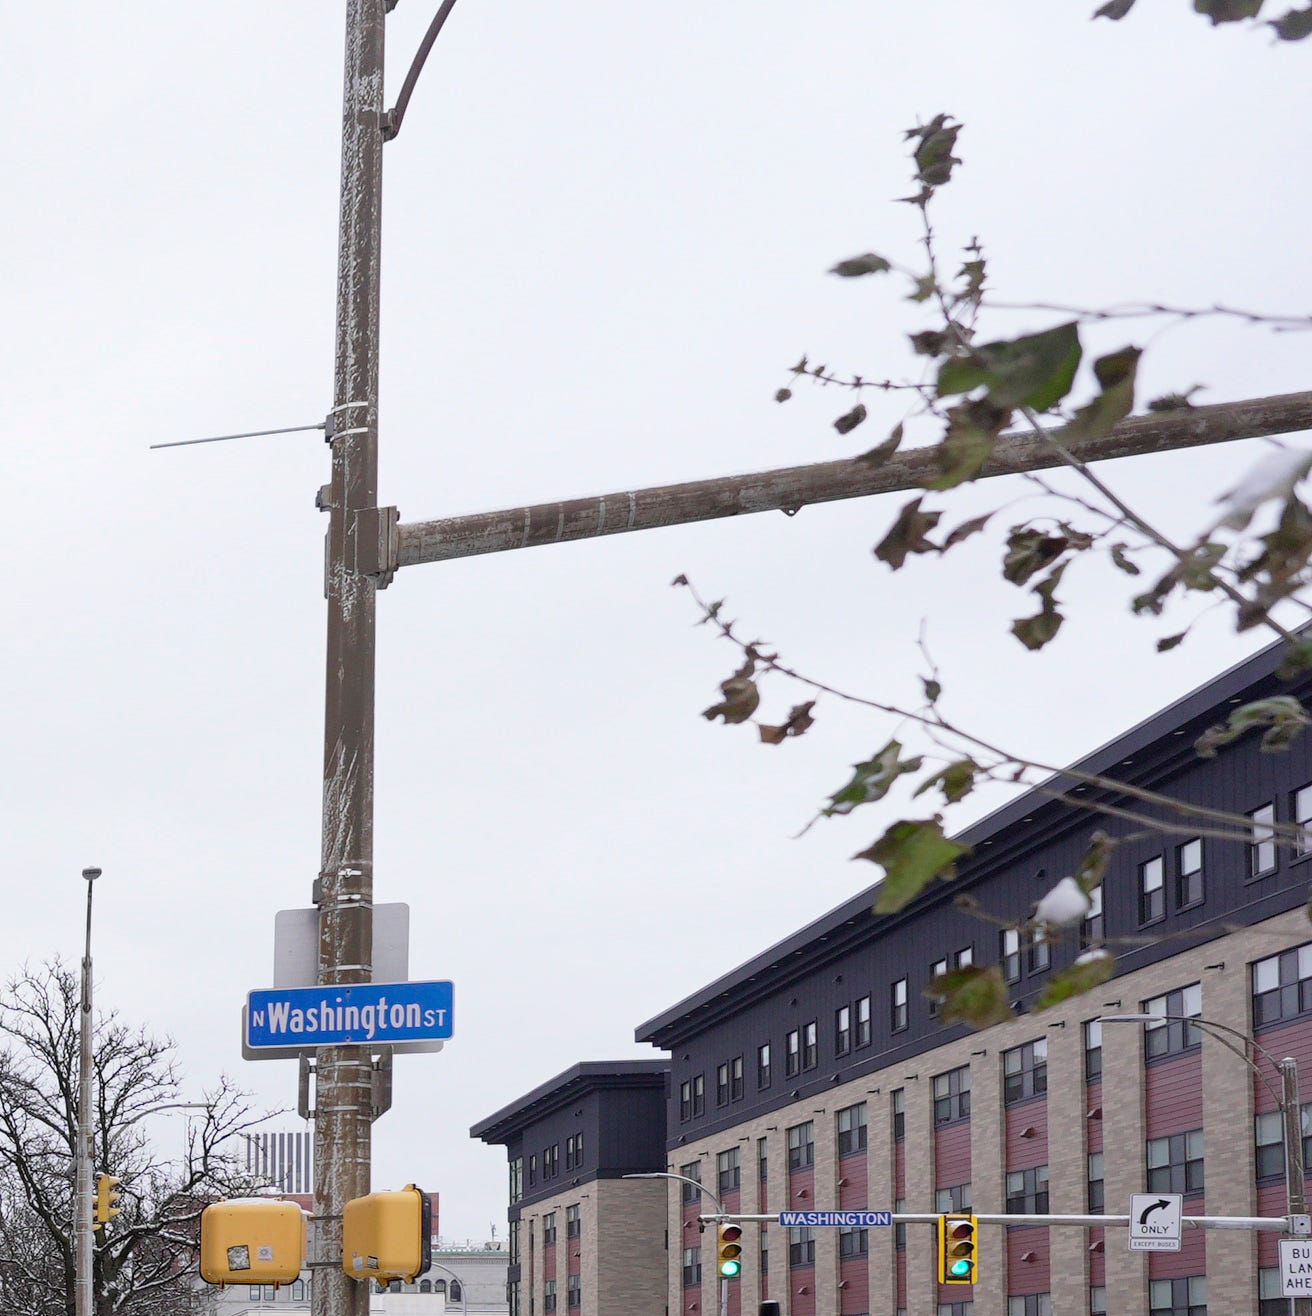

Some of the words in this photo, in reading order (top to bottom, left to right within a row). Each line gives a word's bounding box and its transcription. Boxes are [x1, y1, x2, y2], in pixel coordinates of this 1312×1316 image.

[253, 1011, 264, 1027] N
[268, 997, 421, 1039] Washington
[424, 1010, 446, 1027] ST
[782, 1213, 889, 1225] WASHINGTON
[1141, 1226, 1169, 1234] ONLY
